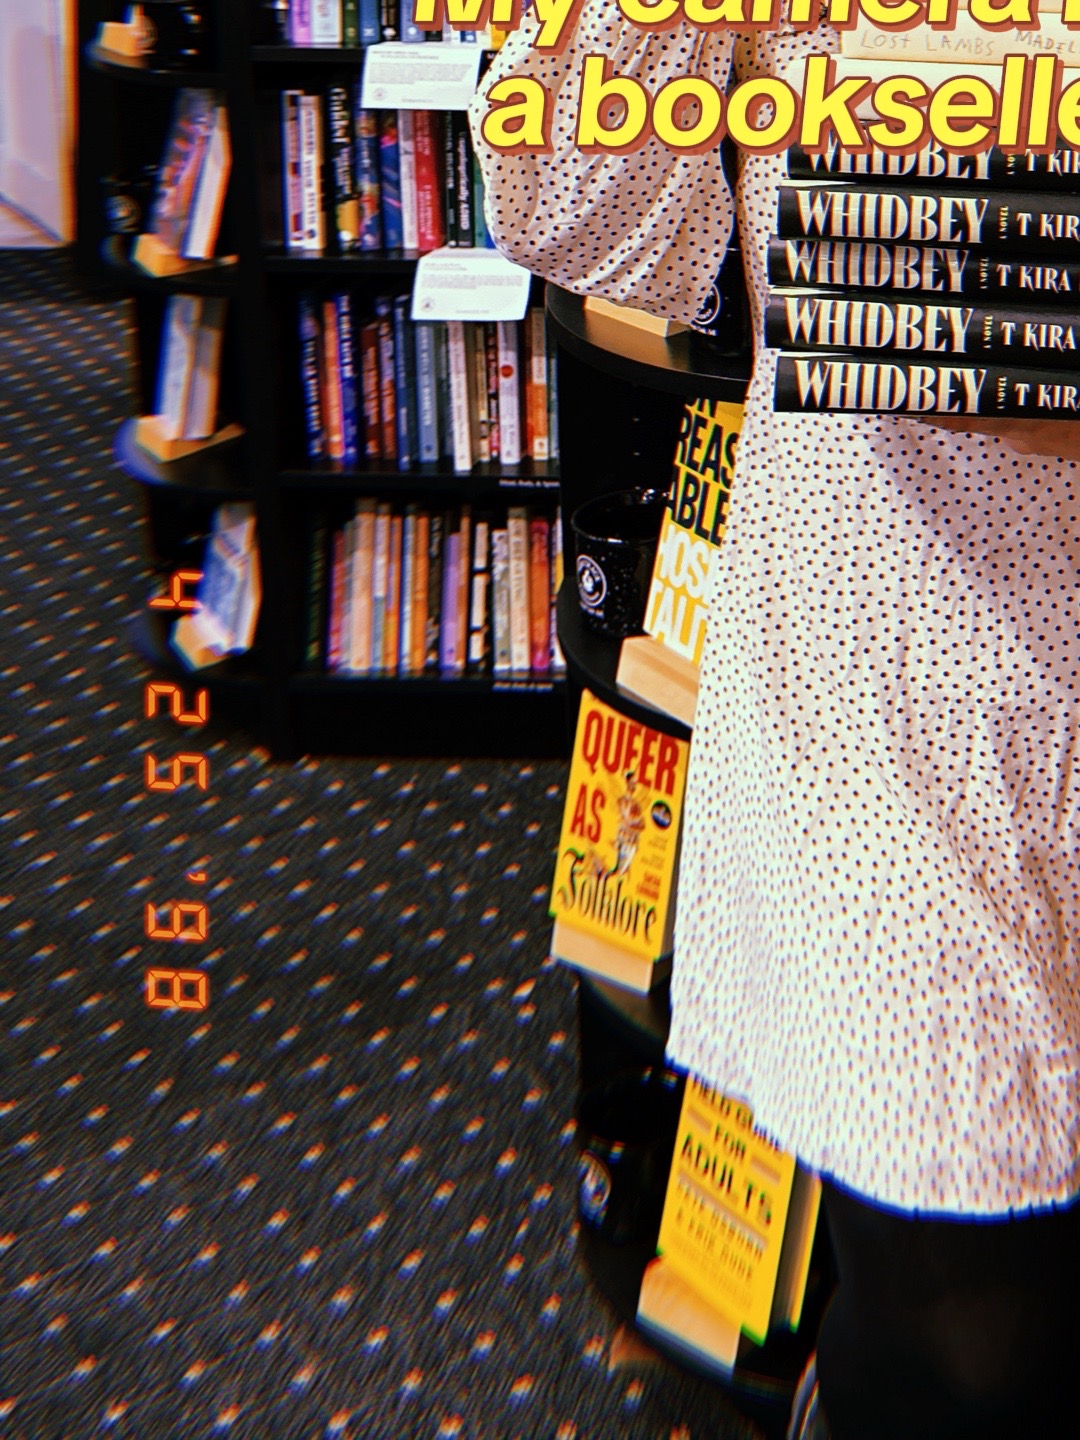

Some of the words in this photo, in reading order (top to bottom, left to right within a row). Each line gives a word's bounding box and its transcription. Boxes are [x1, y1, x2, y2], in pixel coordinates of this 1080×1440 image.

[860, 30, 911, 49] LOST
[924, 32, 995, 57] LAMBS
[805, 140, 995, 181] WHIDBEY
[1026, 149, 1039, 172] T
[795, 190, 990, 244] WHIDBEY
[1016, 212, 1032, 237] T
[784, 239, 970, 293] WHIDBEY
[996, 264, 1012, 287] T
[1019, 265, 1072, 293] KIRA
[784, 296, 974, 353] WHIDBEY
[1001, 321, 1017, 346] T
[1023, 323, 1076, 351] KIRA
[795, 359, 987, 414] WHIDBEY
[1014, 382, 1030, 407] T
[581, 709, 680, 796] QUEER
[570, 783, 606, 844] AS
[556, 847, 657, 944] Folklore
